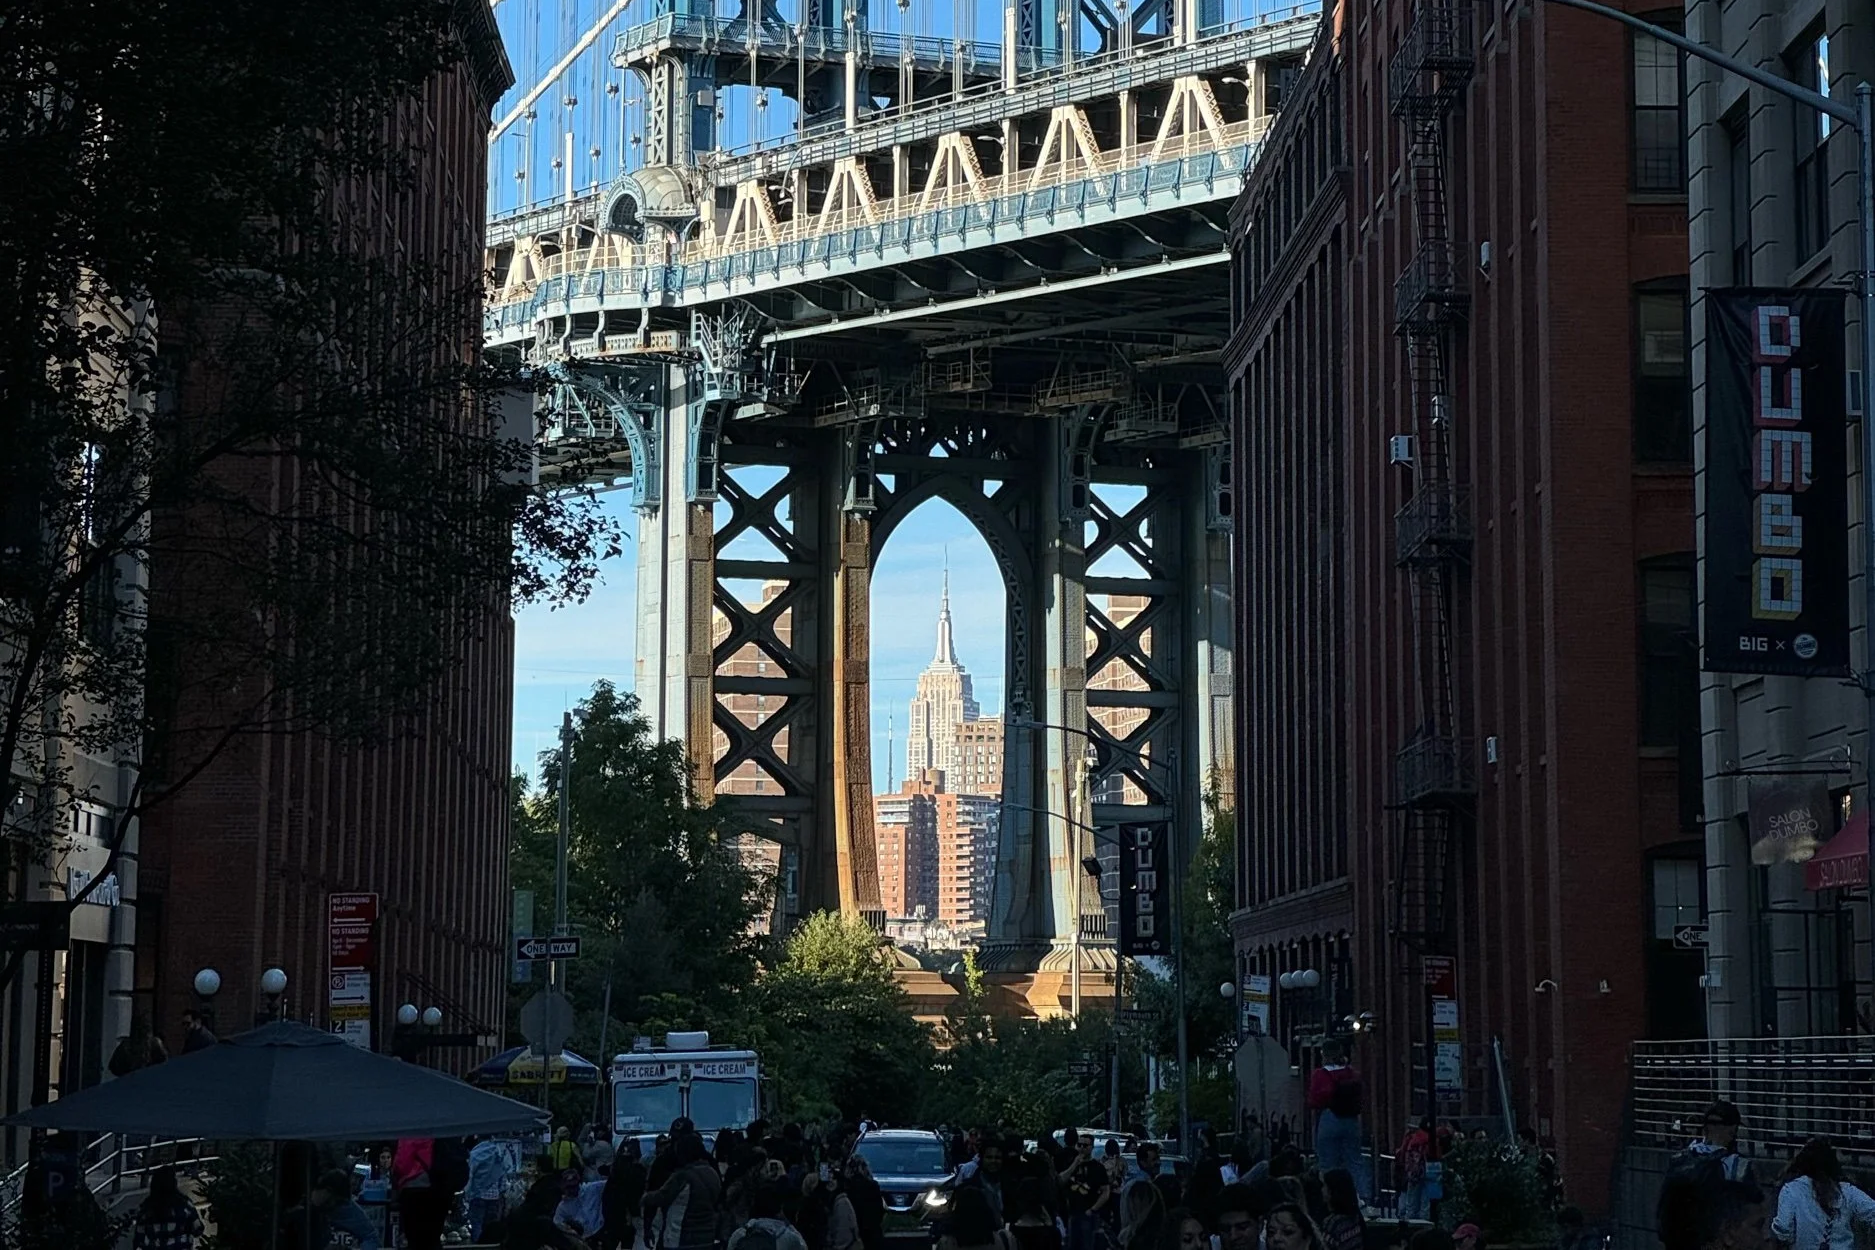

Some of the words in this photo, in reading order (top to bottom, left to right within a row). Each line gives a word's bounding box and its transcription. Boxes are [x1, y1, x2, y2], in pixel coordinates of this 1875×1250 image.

[1752, 305, 1812, 621] DUMBO
[1739, 636, 1769, 652] BIG
[1769, 808, 1811, 828] SALON
[1769, 819, 1818, 841] DUMBO
[1135, 827, 1157, 937] DUMBO
[341, 896, 370, 904] STANDING
[332, 905, 356, 913] Anytime
[341, 927, 370, 935] STANDING
[1682, 930, 1702, 941] ONE
[526, 944, 545, 954] ONE
[553, 944, 572, 952] WAY
[623, 1066, 636, 1078] ICE
[703, 1064, 716, 1075] ICE
[718, 1063, 746, 1074] CREAM
